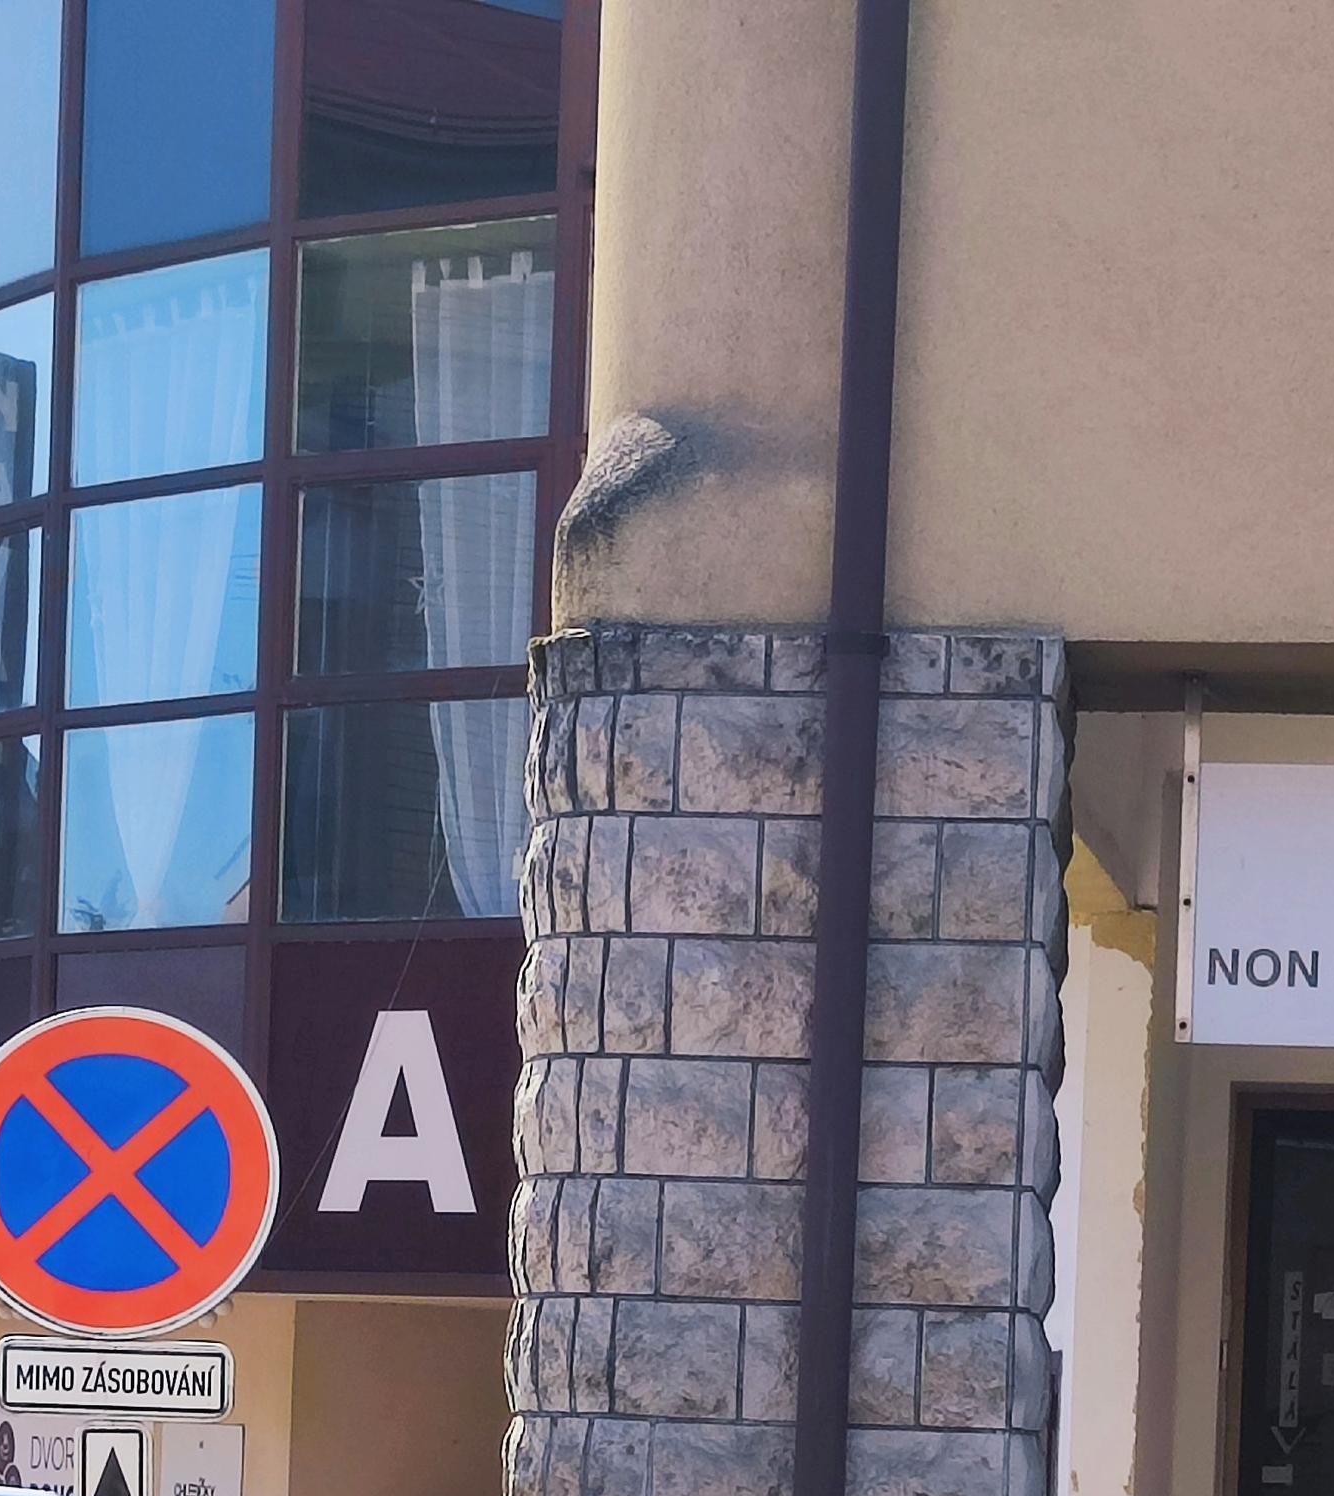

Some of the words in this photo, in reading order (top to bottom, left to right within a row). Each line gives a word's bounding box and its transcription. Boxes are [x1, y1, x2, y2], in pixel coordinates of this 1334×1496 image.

[1207, 948, 1320, 989] NON
[16, 1364, 74, 1392] MIMO
[81, 1360, 216, 1397] ZÁSOBOVÁNÍ
